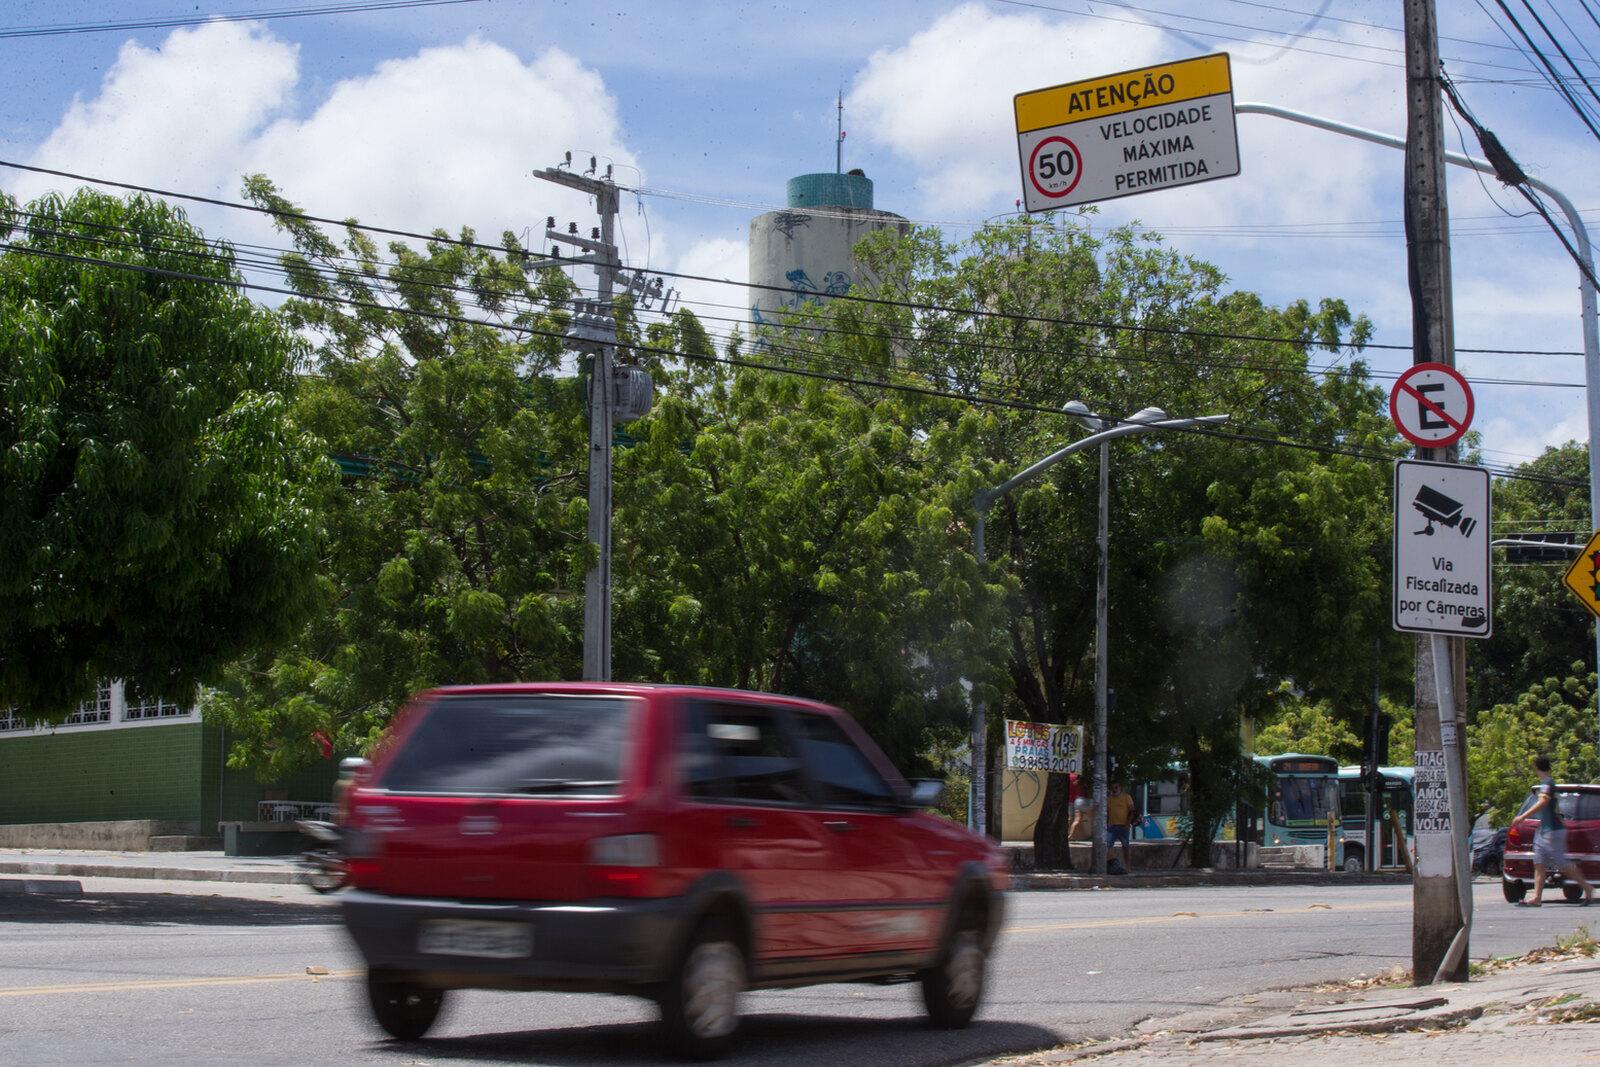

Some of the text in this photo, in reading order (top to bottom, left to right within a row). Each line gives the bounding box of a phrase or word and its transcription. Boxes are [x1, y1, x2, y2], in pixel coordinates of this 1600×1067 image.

[1068, 74, 1175, 114] ATENÇÃO
[1100, 105, 1212, 140] VELOCIDADE
[1123, 135, 1194, 163] MÁXIMA
[1039, 150, 1074, 180] 50
[1115, 159, 1209, 190] PERMITIDA
[1049, 180, 1067, 189] km/h
[1416, 383, 1449, 430] E
[1432, 557, 1453, 571] Via
[1406, 576, 1478, 595] Fiscalizada
[1400, 600, 1485, 617] por Câmeras
[1015, 746, 1050, 757] PRAIAS
[1416, 818, 1451, 830] VOLTA
